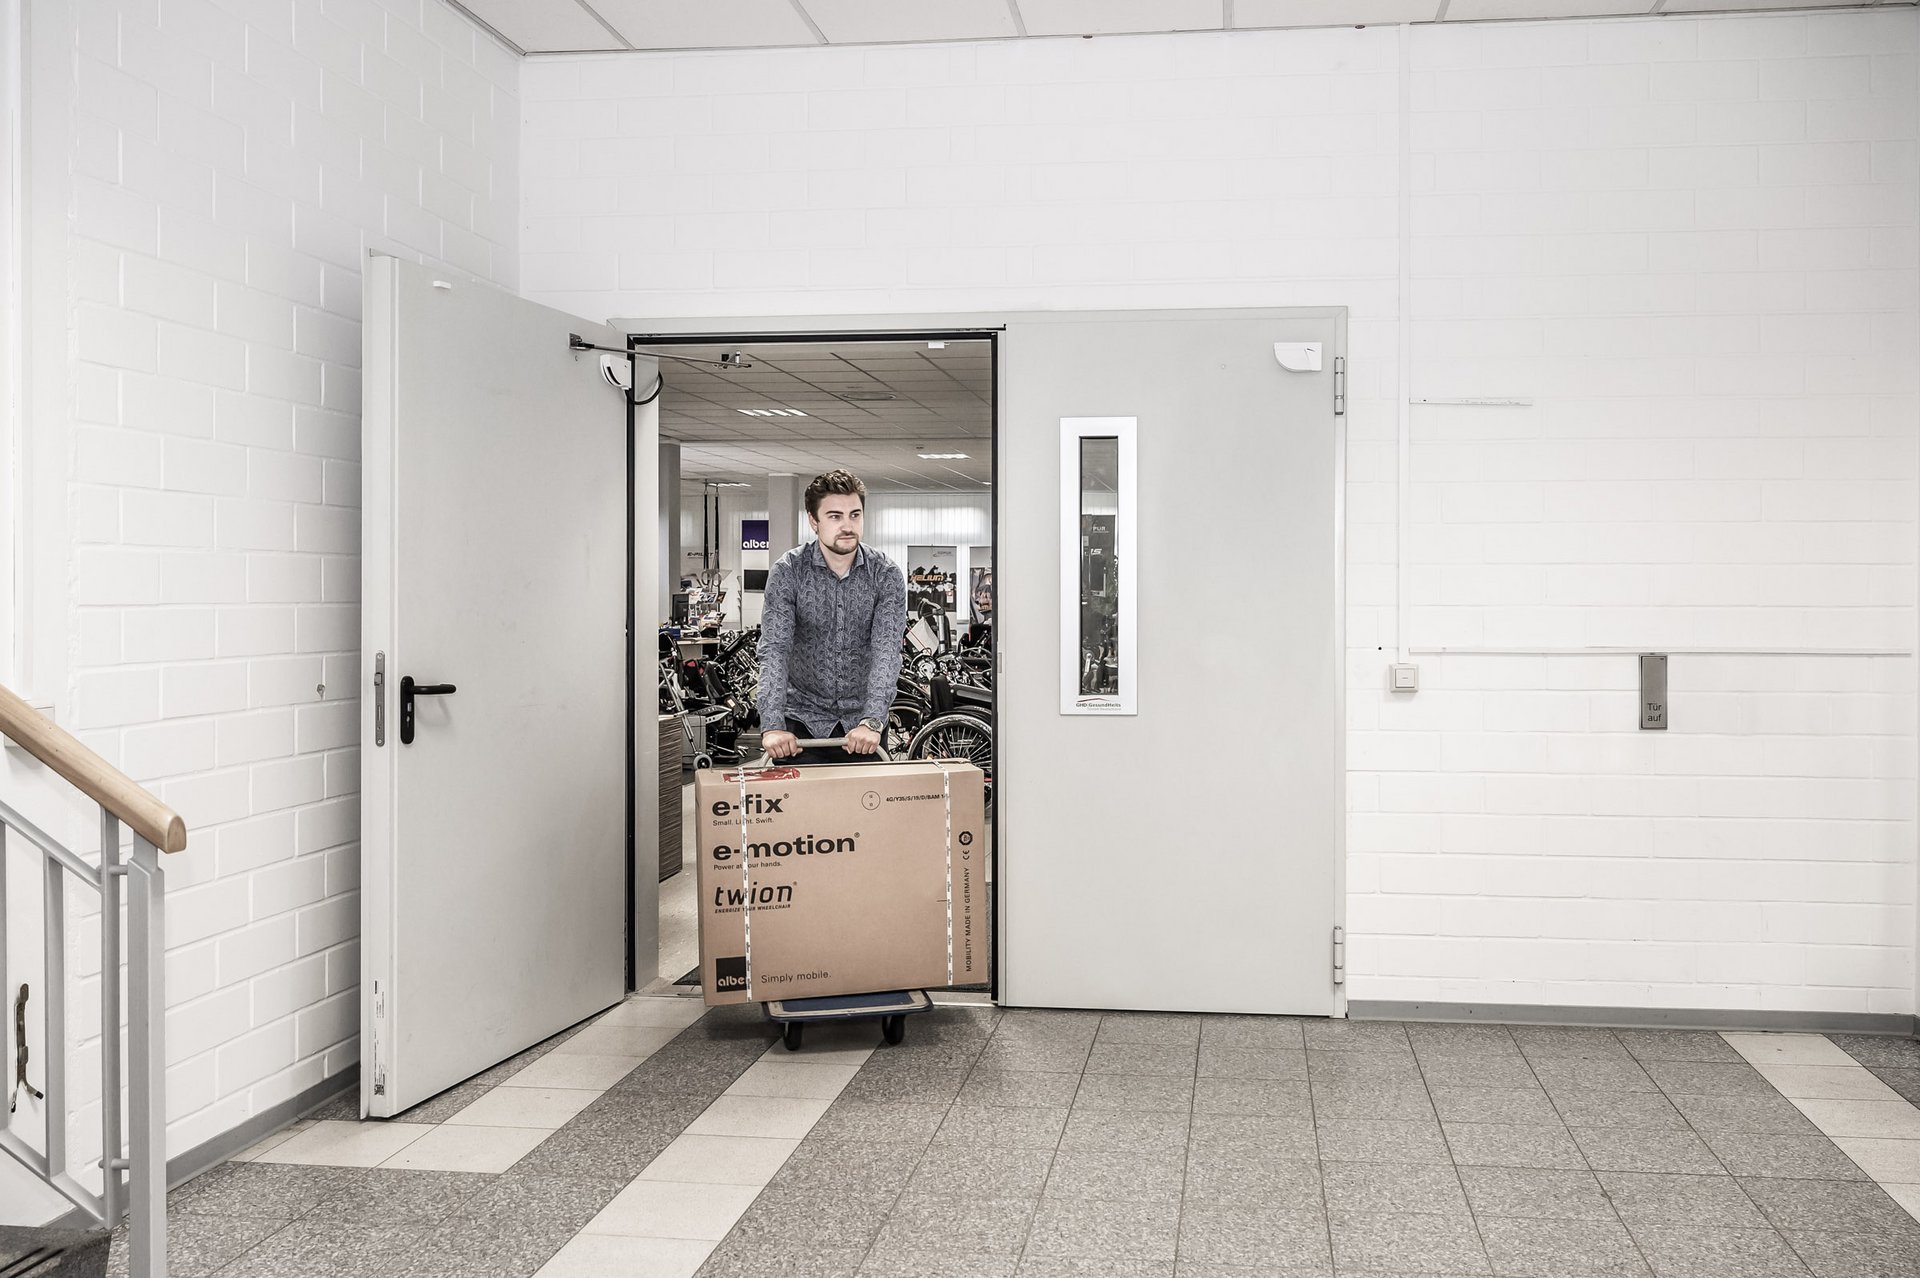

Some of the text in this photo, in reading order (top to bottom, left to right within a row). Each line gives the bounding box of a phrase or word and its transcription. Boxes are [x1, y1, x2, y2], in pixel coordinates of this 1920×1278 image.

[1647, 702, 1662, 711] Tür
[1647, 713, 1662, 721] auf
[964, 905, 971, 915] IN
[717, 975, 746, 987] albe
[761, 971, 832, 983] Simply mobile.
